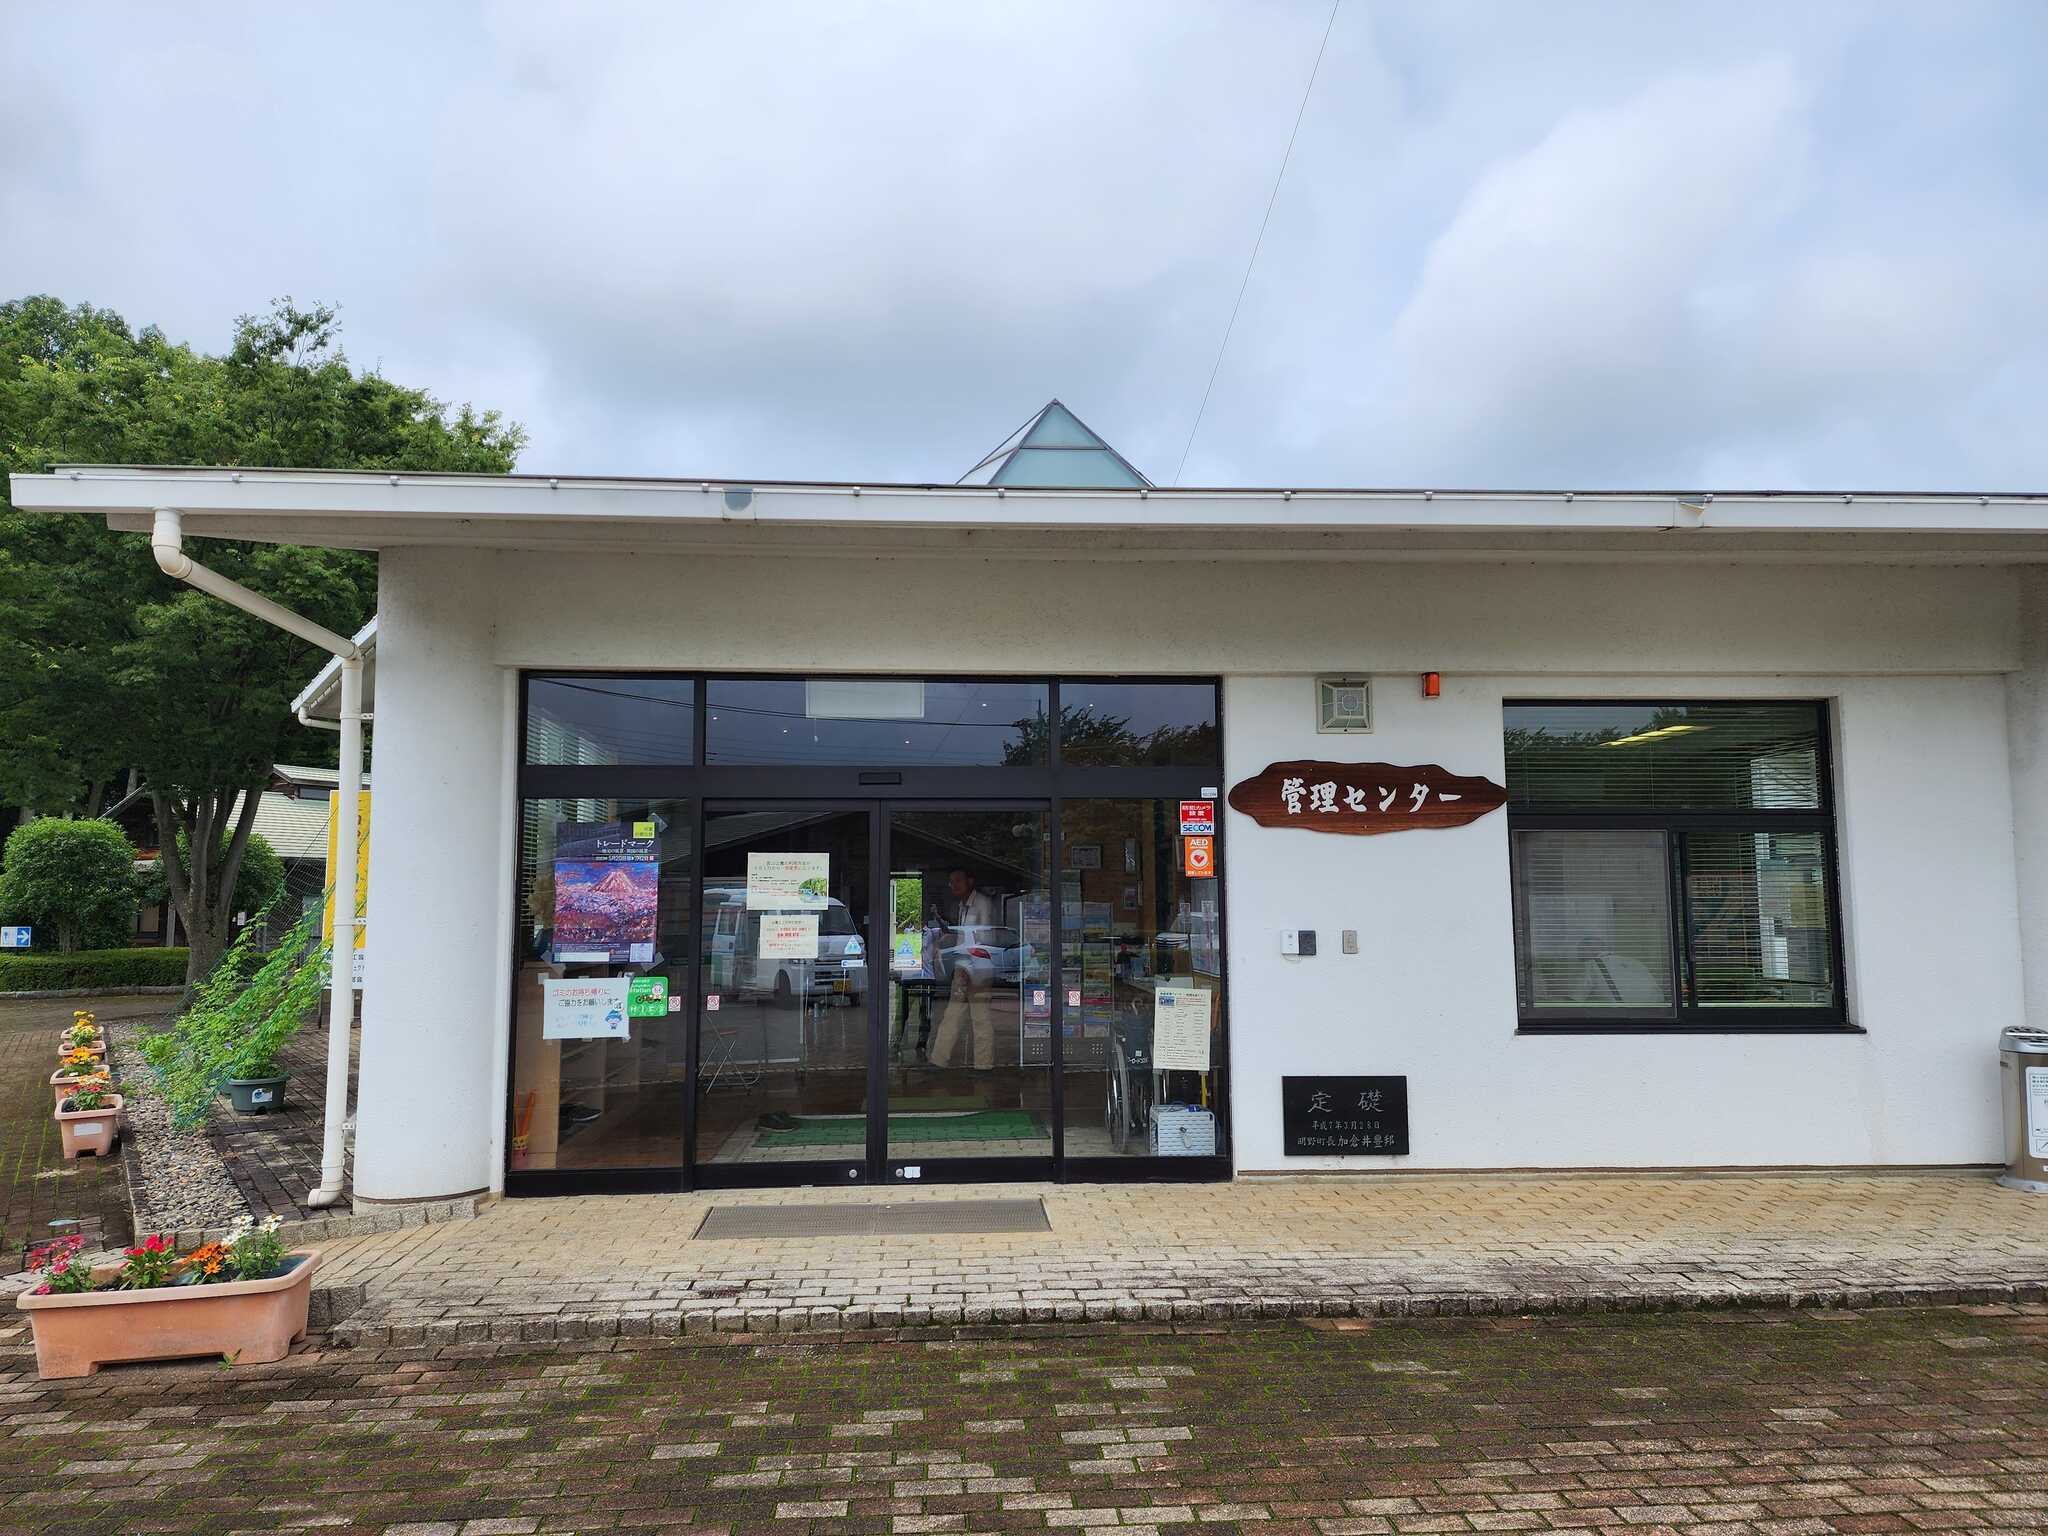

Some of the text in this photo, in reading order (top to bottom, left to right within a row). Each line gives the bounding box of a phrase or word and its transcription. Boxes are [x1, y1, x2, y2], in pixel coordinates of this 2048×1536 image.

[1280, 777, 1462, 815] 管理センター
[597, 839, 655, 848] トレードマーク
[1307, 1088, 1385, 1113] 定礎
